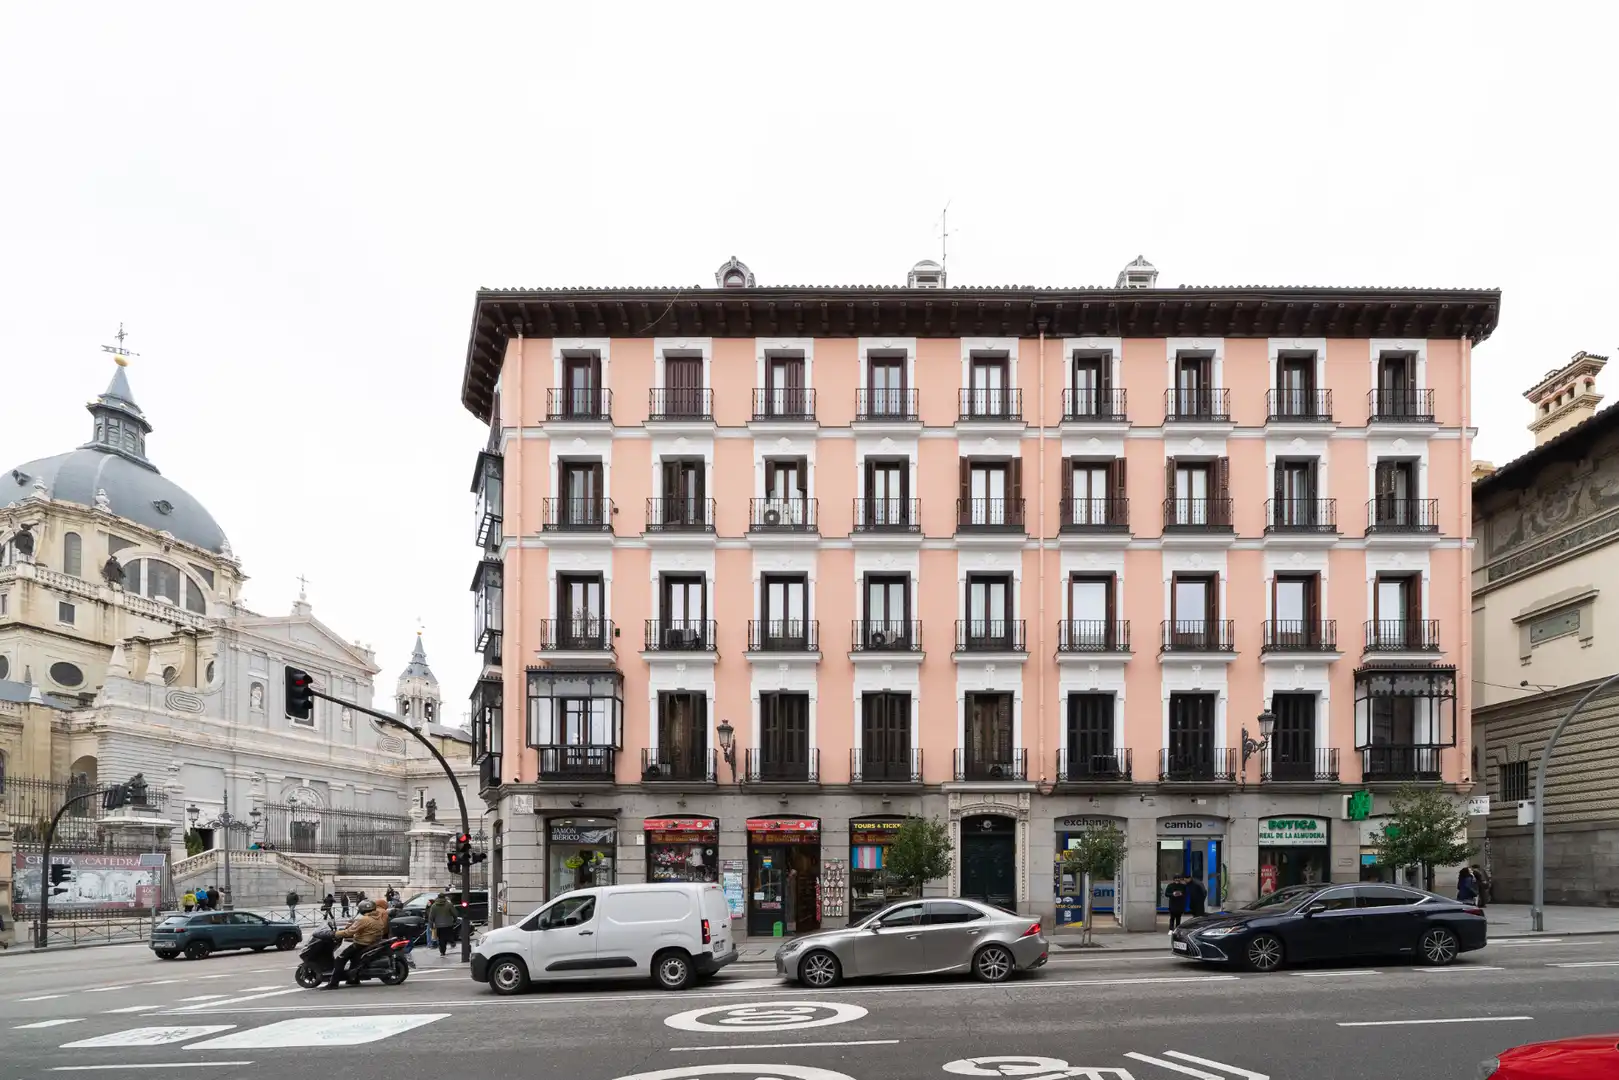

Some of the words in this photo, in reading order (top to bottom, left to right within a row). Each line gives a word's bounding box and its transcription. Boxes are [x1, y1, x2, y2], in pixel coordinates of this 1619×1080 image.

[1164, 820, 1203, 829] cambio
[1267, 820, 1317, 830] BOTICA
[25, 856, 76, 865] CRPTA
[85, 857, 141, 866] CATEDRA
